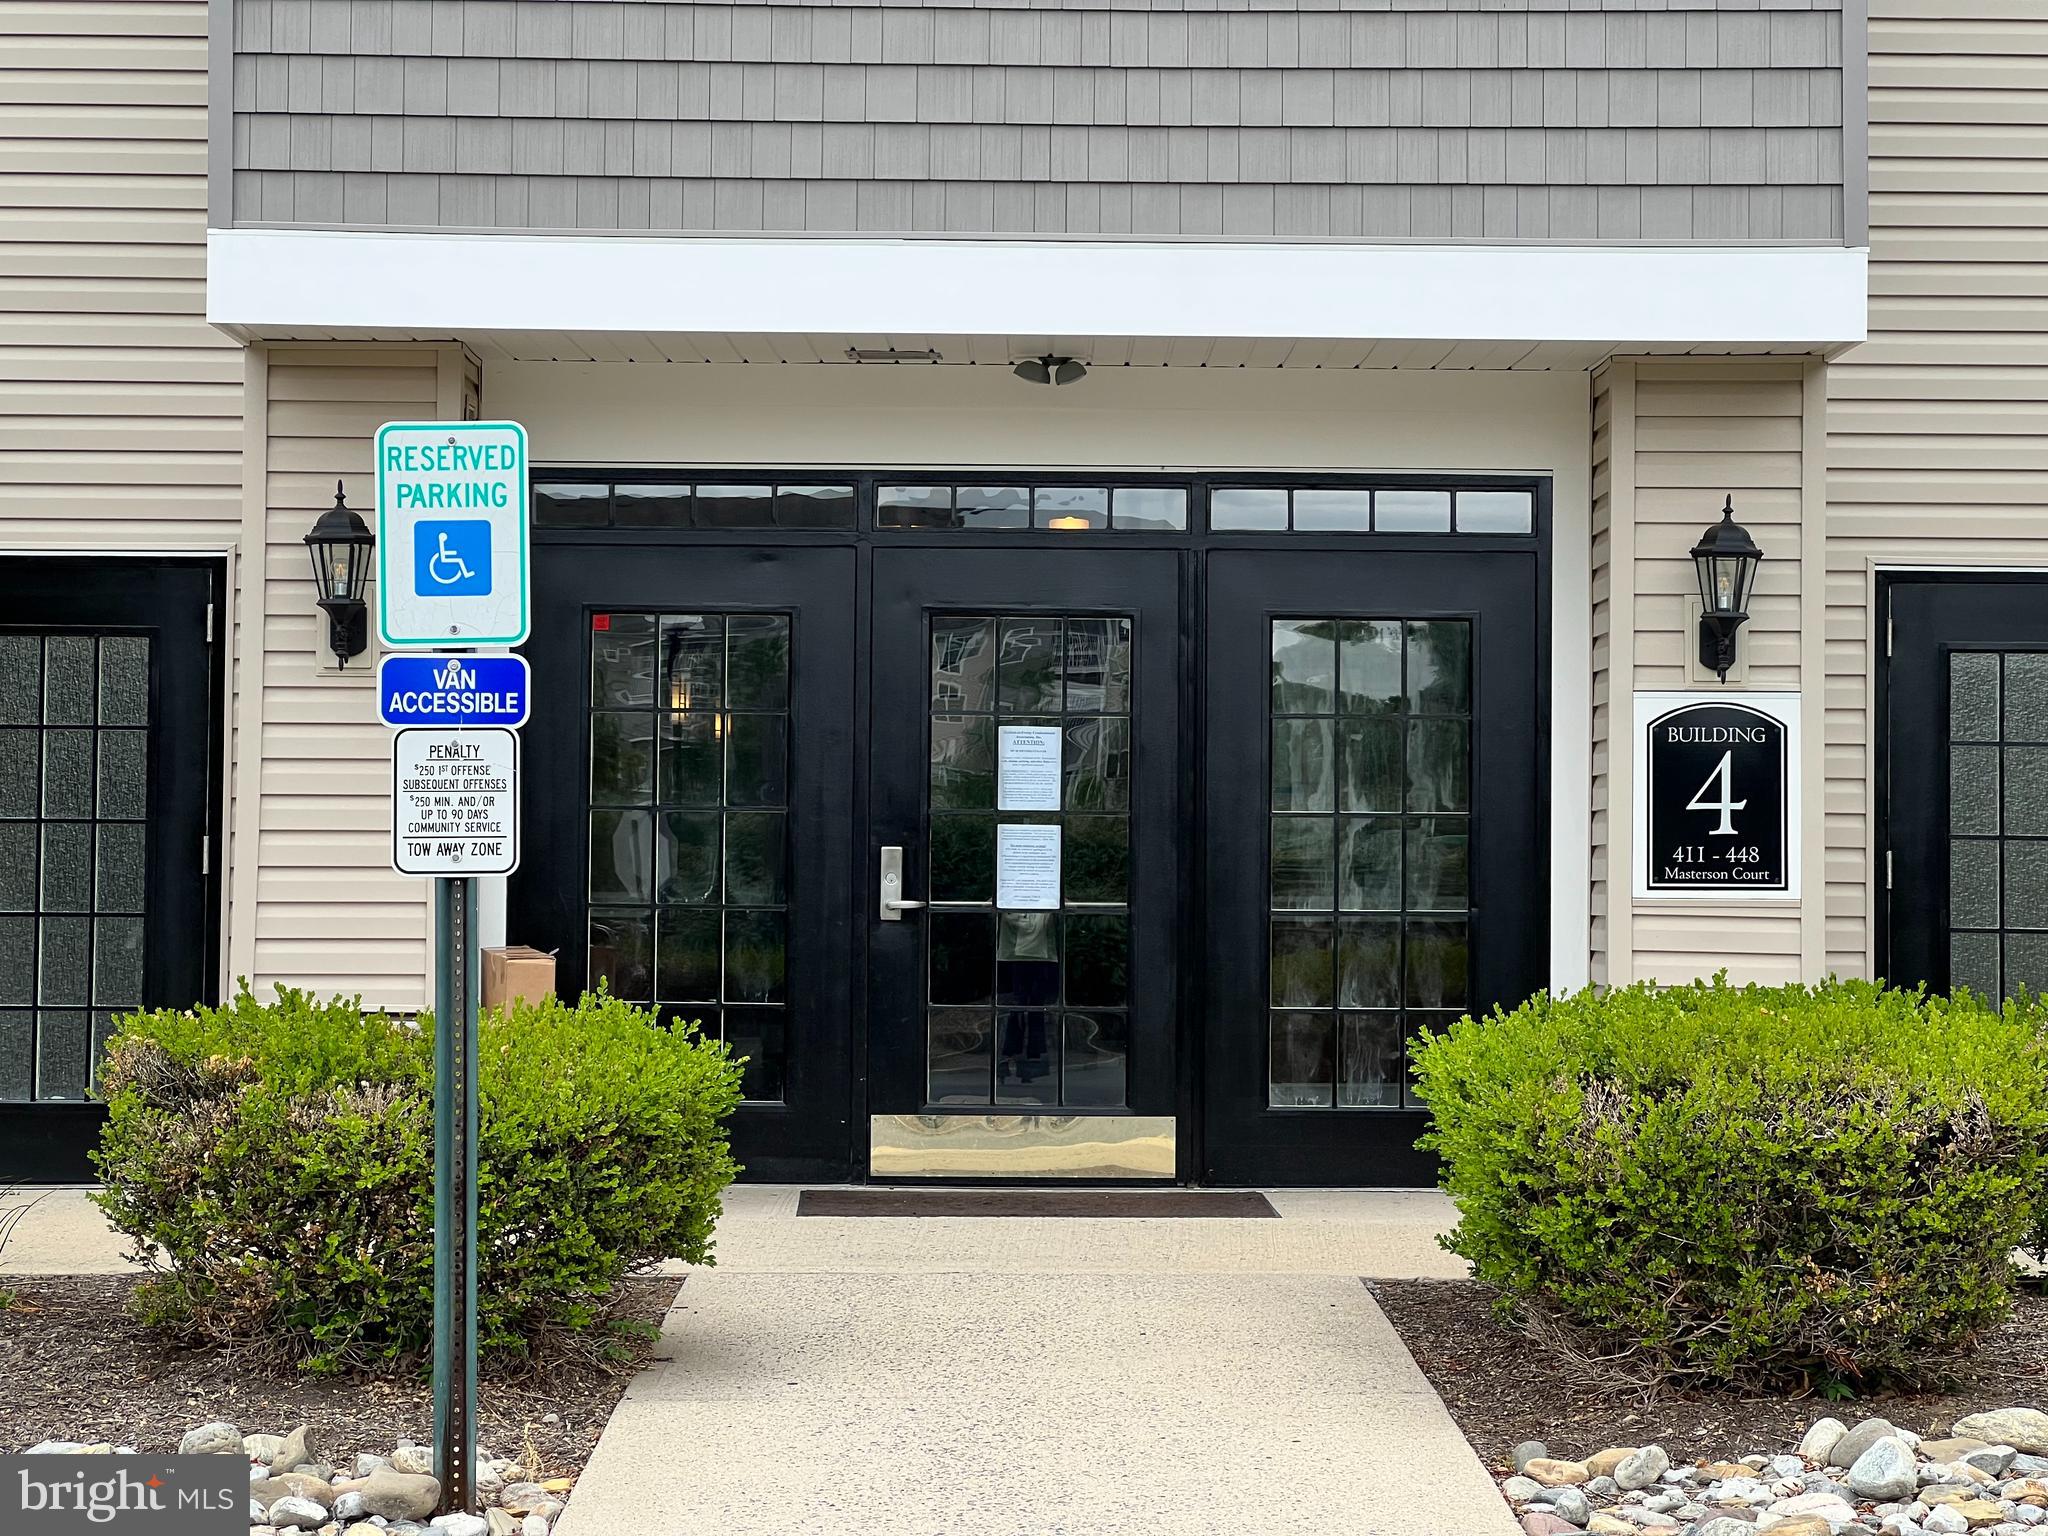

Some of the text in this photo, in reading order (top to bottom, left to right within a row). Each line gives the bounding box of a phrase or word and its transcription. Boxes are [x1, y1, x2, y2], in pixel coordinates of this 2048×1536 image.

[387, 445, 515, 472] RESERVED
[397, 482, 507, 508] PARKING
[433, 669, 476, 689] VAN
[389, 692, 518, 713] ACCESSIBLE
[1667, 727, 1766, 743] BUILDING
[429, 744, 480, 759] PENALTY
[414, 764, 435, 776] $250
[451, 765, 491, 776] OFFENSE
[403, 778, 507, 790] SUBSEQUENT OFFENSES
[1686, 750, 1747, 835] 4
[410, 795, 495, 807] $250 MIN. AND/OR
[421, 809, 489, 820] UP TO 90 DAYS
[408, 822, 501, 833] COMMUNITY SERVICE
[408, 842, 503, 857] TOW AWAY ZONE
[1672, 846, 1705, 863] 411
[1725, 846, 1760, 863] 448
[1664, 867, 1770, 880] Masterson Court
